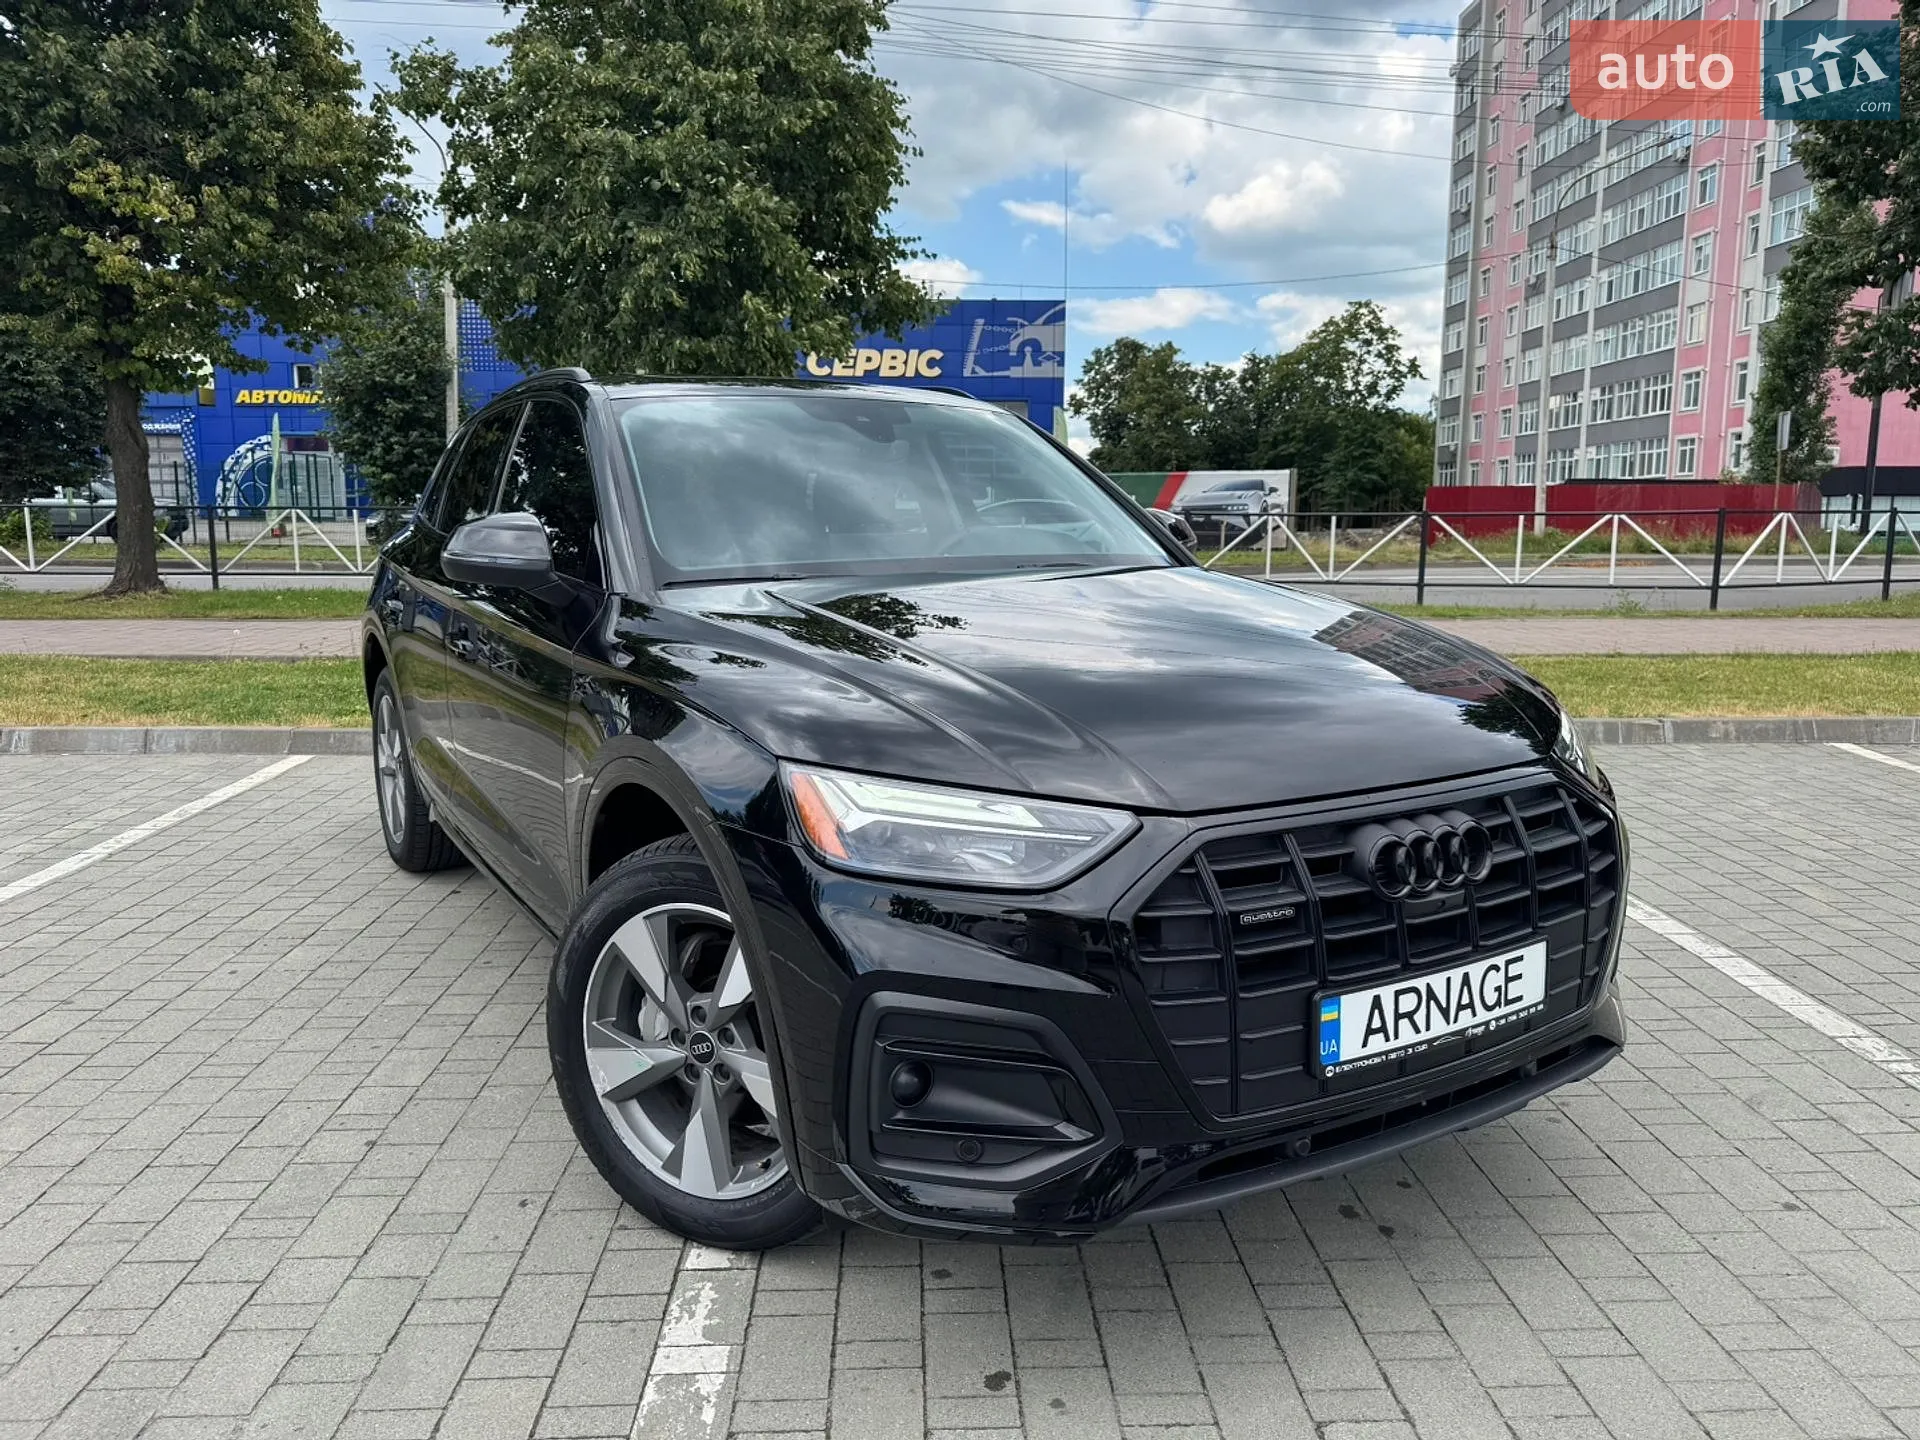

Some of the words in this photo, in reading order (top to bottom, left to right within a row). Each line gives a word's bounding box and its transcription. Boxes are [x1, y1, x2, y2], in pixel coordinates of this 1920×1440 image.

[806, 349, 944, 377] СЕРВІС
[1243, 908, 1294, 923] quattro
[1361, 955, 1524, 1049] ARNAGE
[1320, 1039, 1338, 1055] UA
